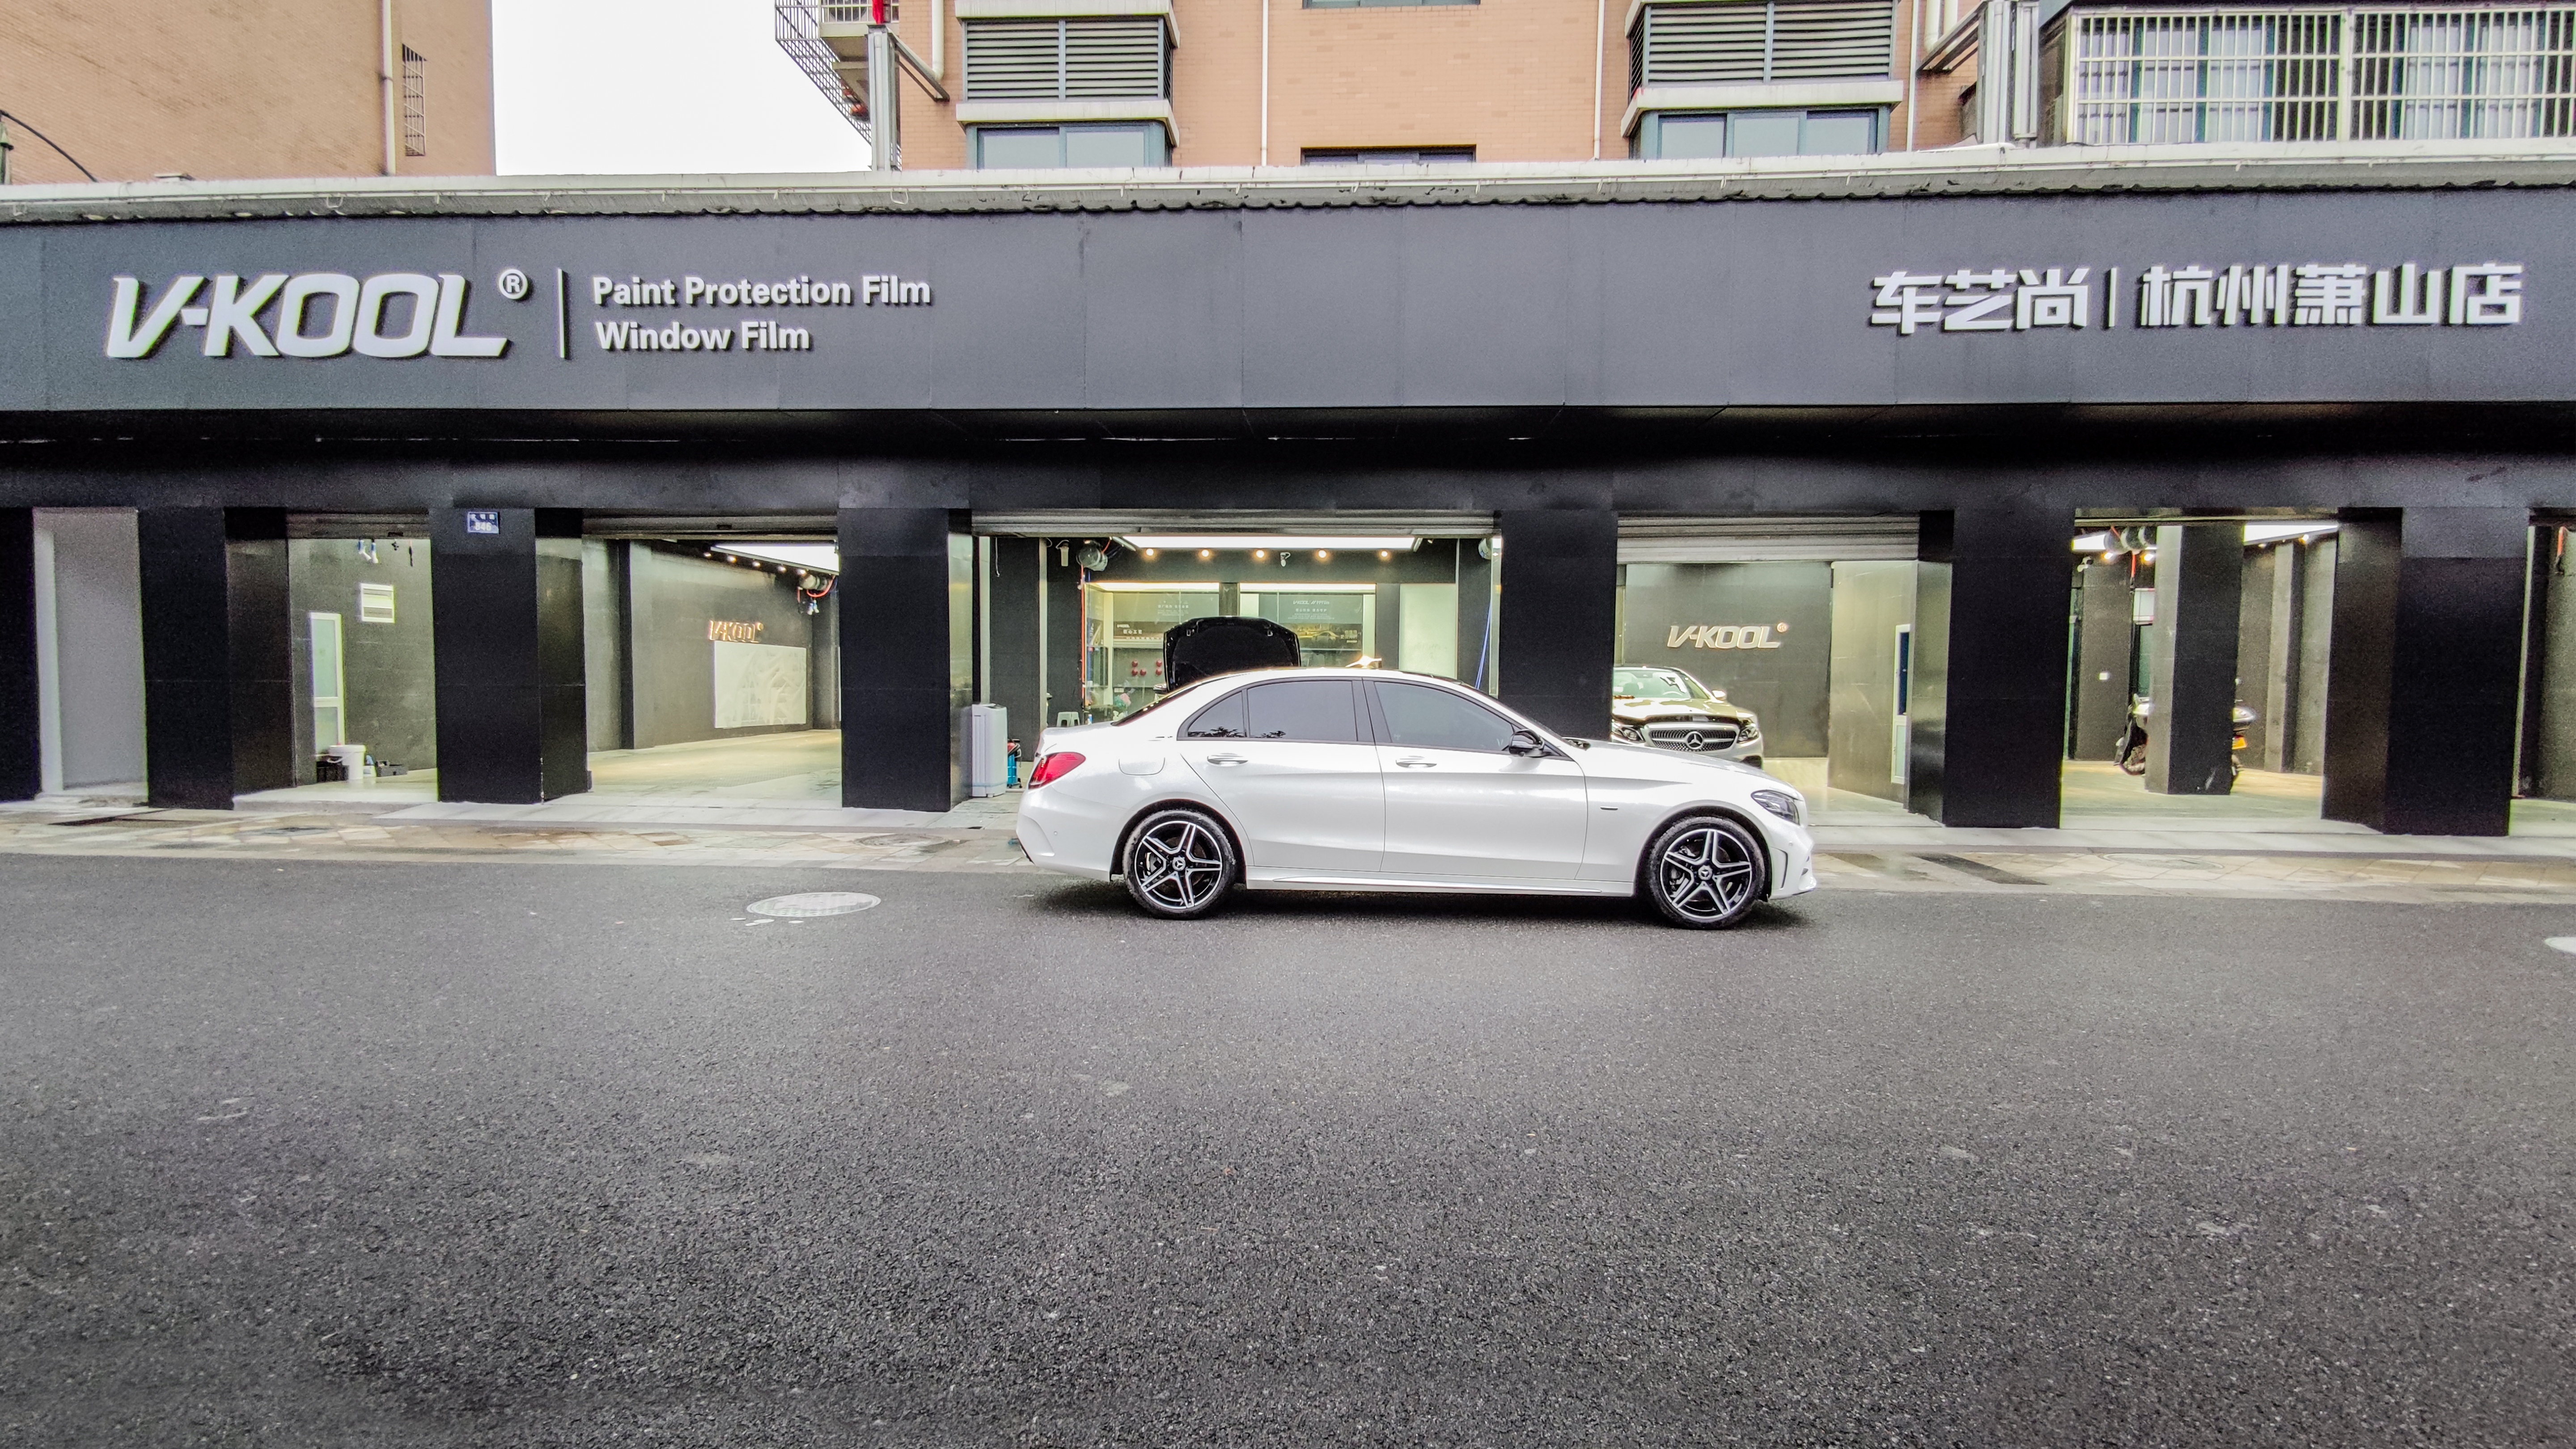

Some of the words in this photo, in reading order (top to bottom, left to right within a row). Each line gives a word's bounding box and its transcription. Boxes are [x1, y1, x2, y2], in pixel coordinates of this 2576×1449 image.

[593, 276, 675, 305] Paint
[685, 275, 851, 305] Protection
[862, 275, 930, 304] Film
[1871, 267, 2090, 334] 车艺尚
[2141, 263, 2523, 326] 杭州萧山店
[595, 320, 731, 349] Window
[741, 320, 809, 349] Film
